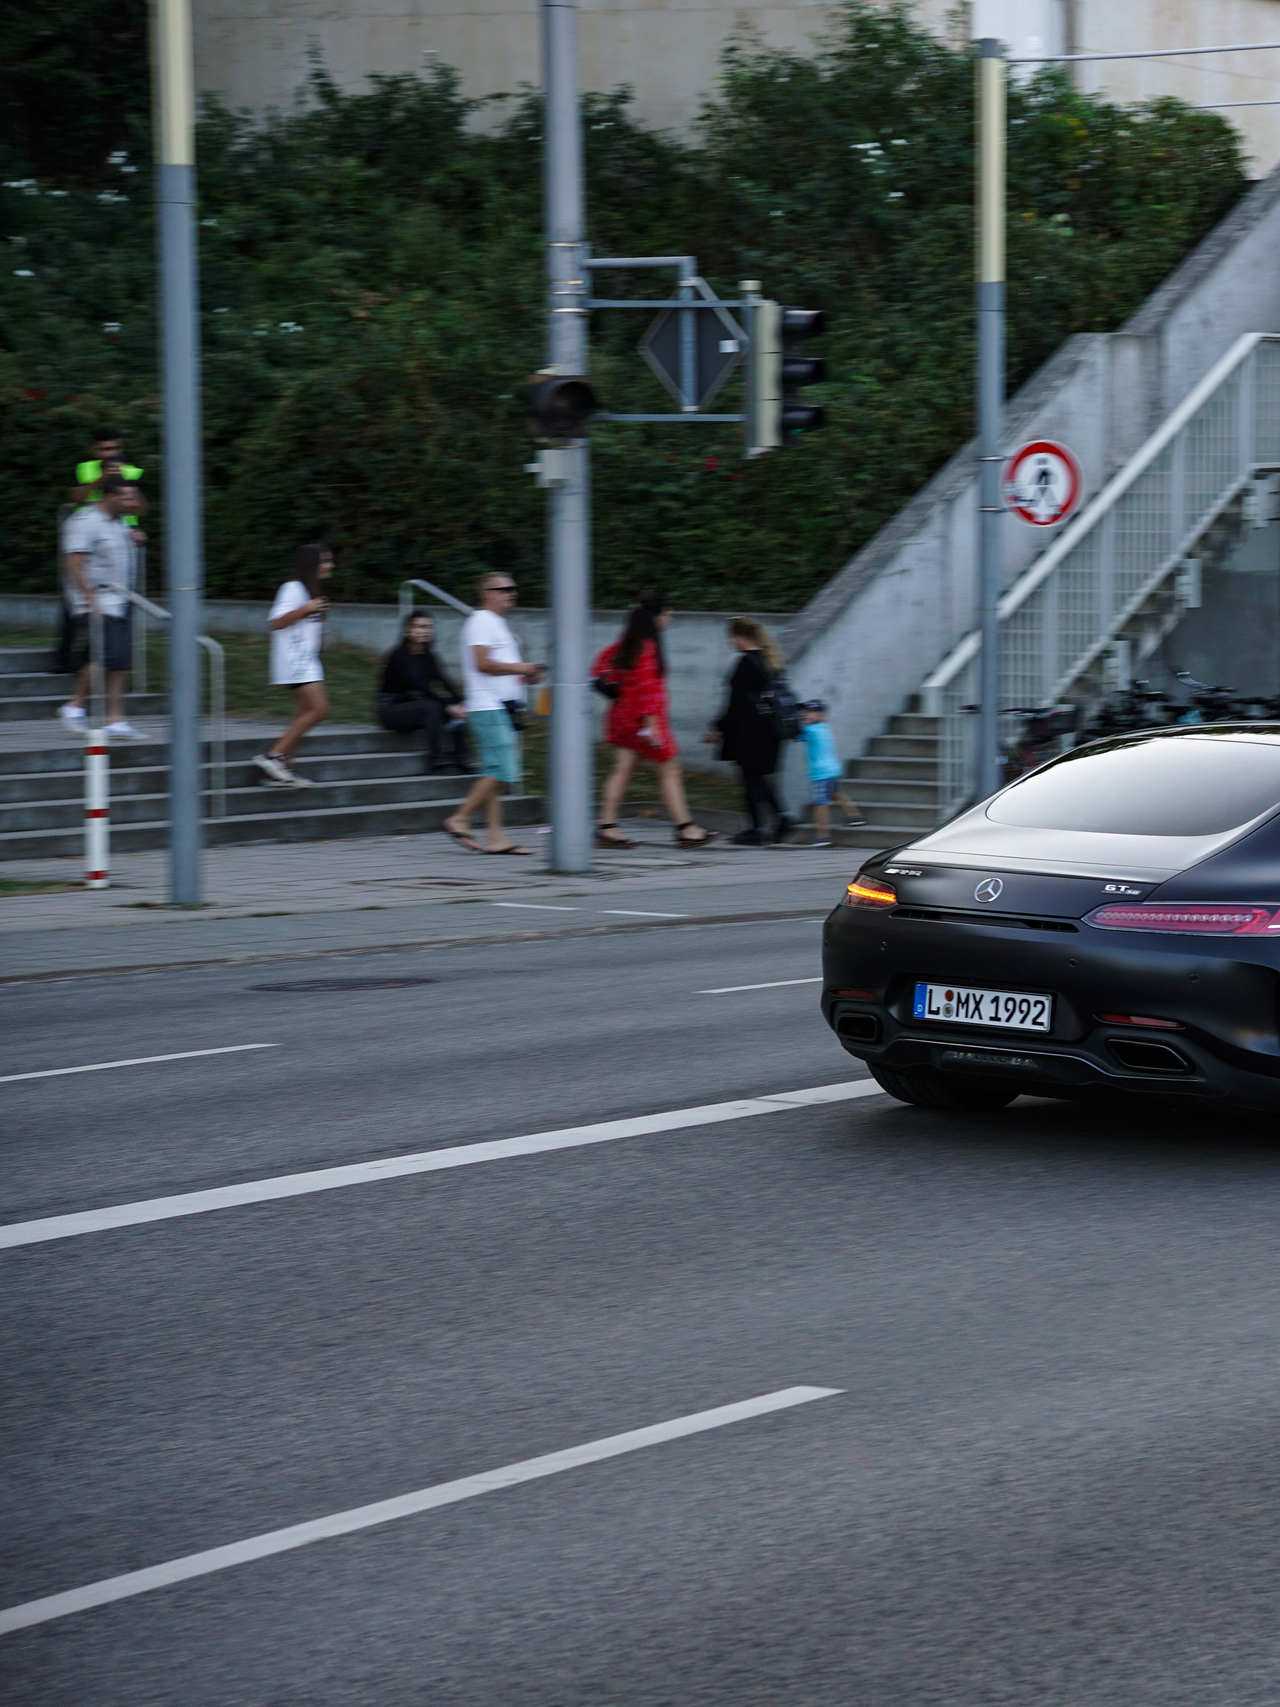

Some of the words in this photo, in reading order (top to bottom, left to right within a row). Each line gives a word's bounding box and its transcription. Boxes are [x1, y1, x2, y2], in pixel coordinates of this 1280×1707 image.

[1104, 884, 1130, 892] GT
[927, 988, 940, 1016] L
[955, 991, 984, 1020] MX
[989, 995, 1046, 1027] 1992
